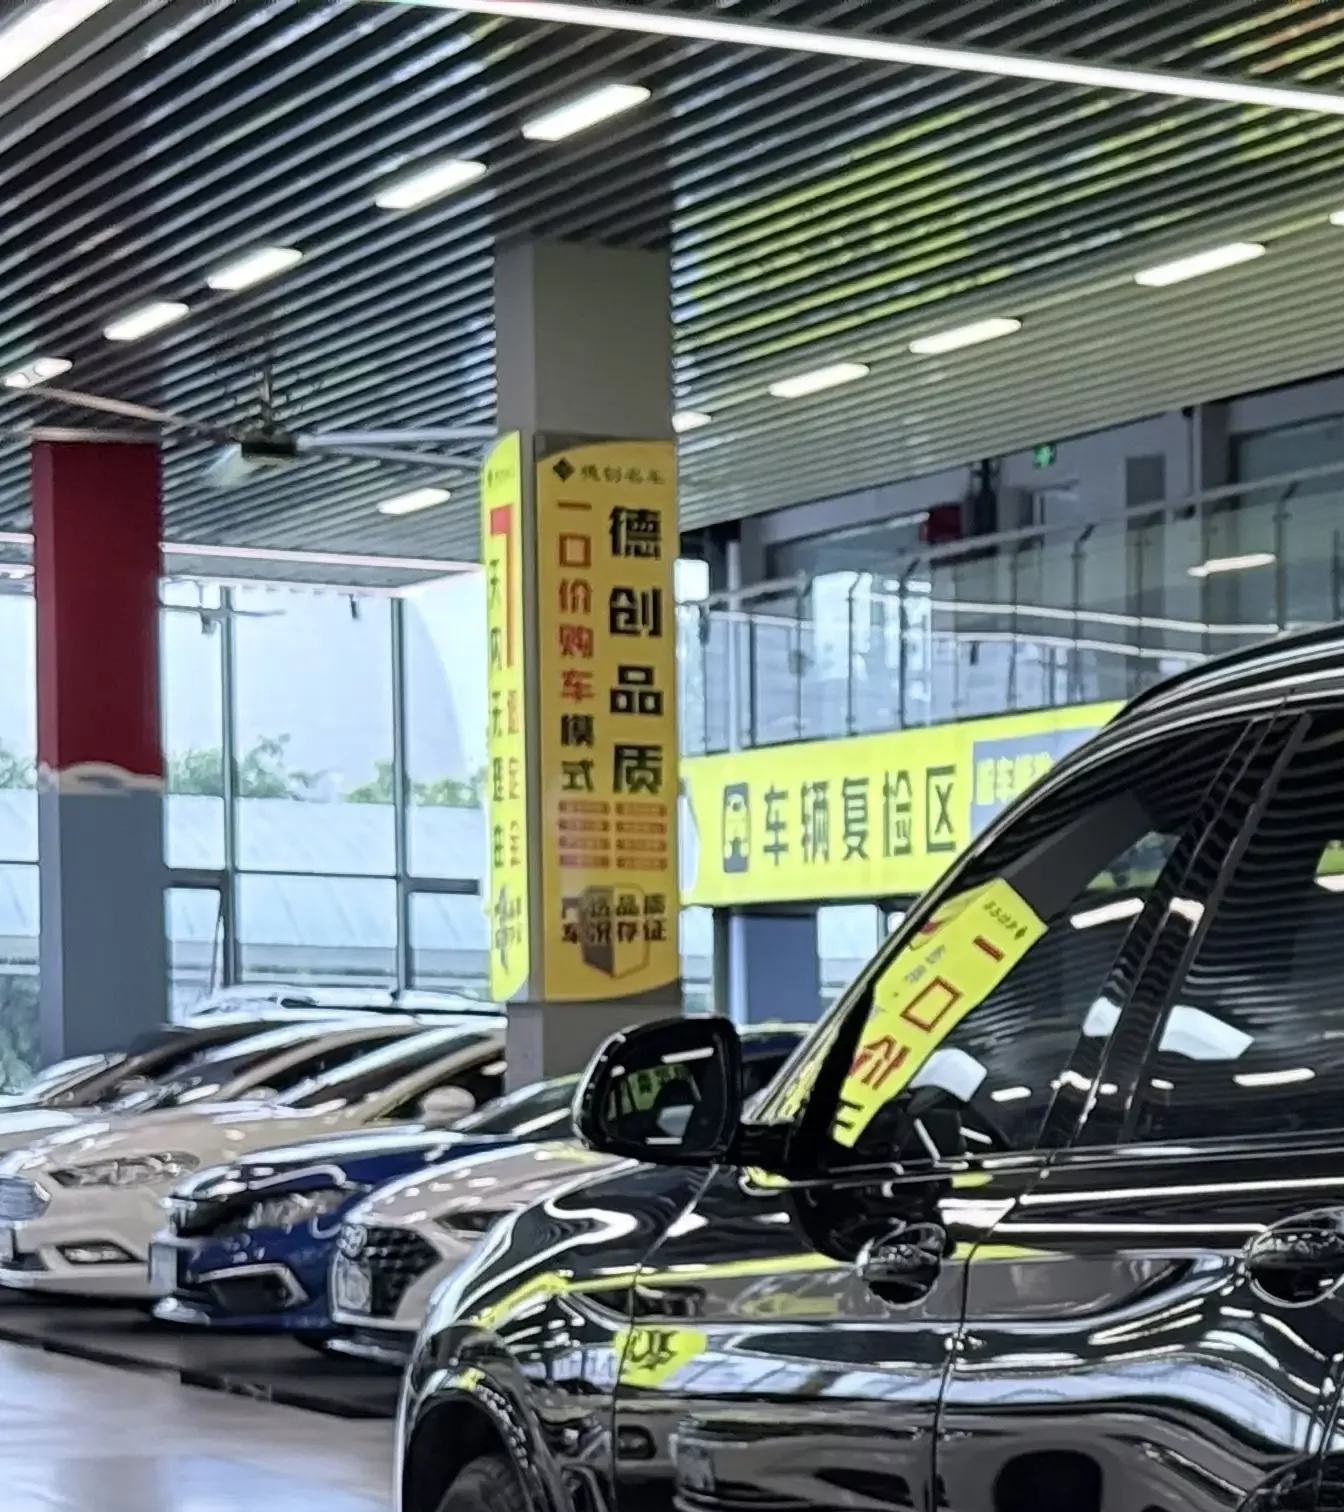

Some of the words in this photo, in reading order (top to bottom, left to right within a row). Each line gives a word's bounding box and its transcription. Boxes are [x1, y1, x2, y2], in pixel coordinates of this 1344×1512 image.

[556, 499, 596, 792] 一口价购车模式
[609, 505, 664, 794] 德创品质
[763, 764, 957, 868] 车辆复检区
